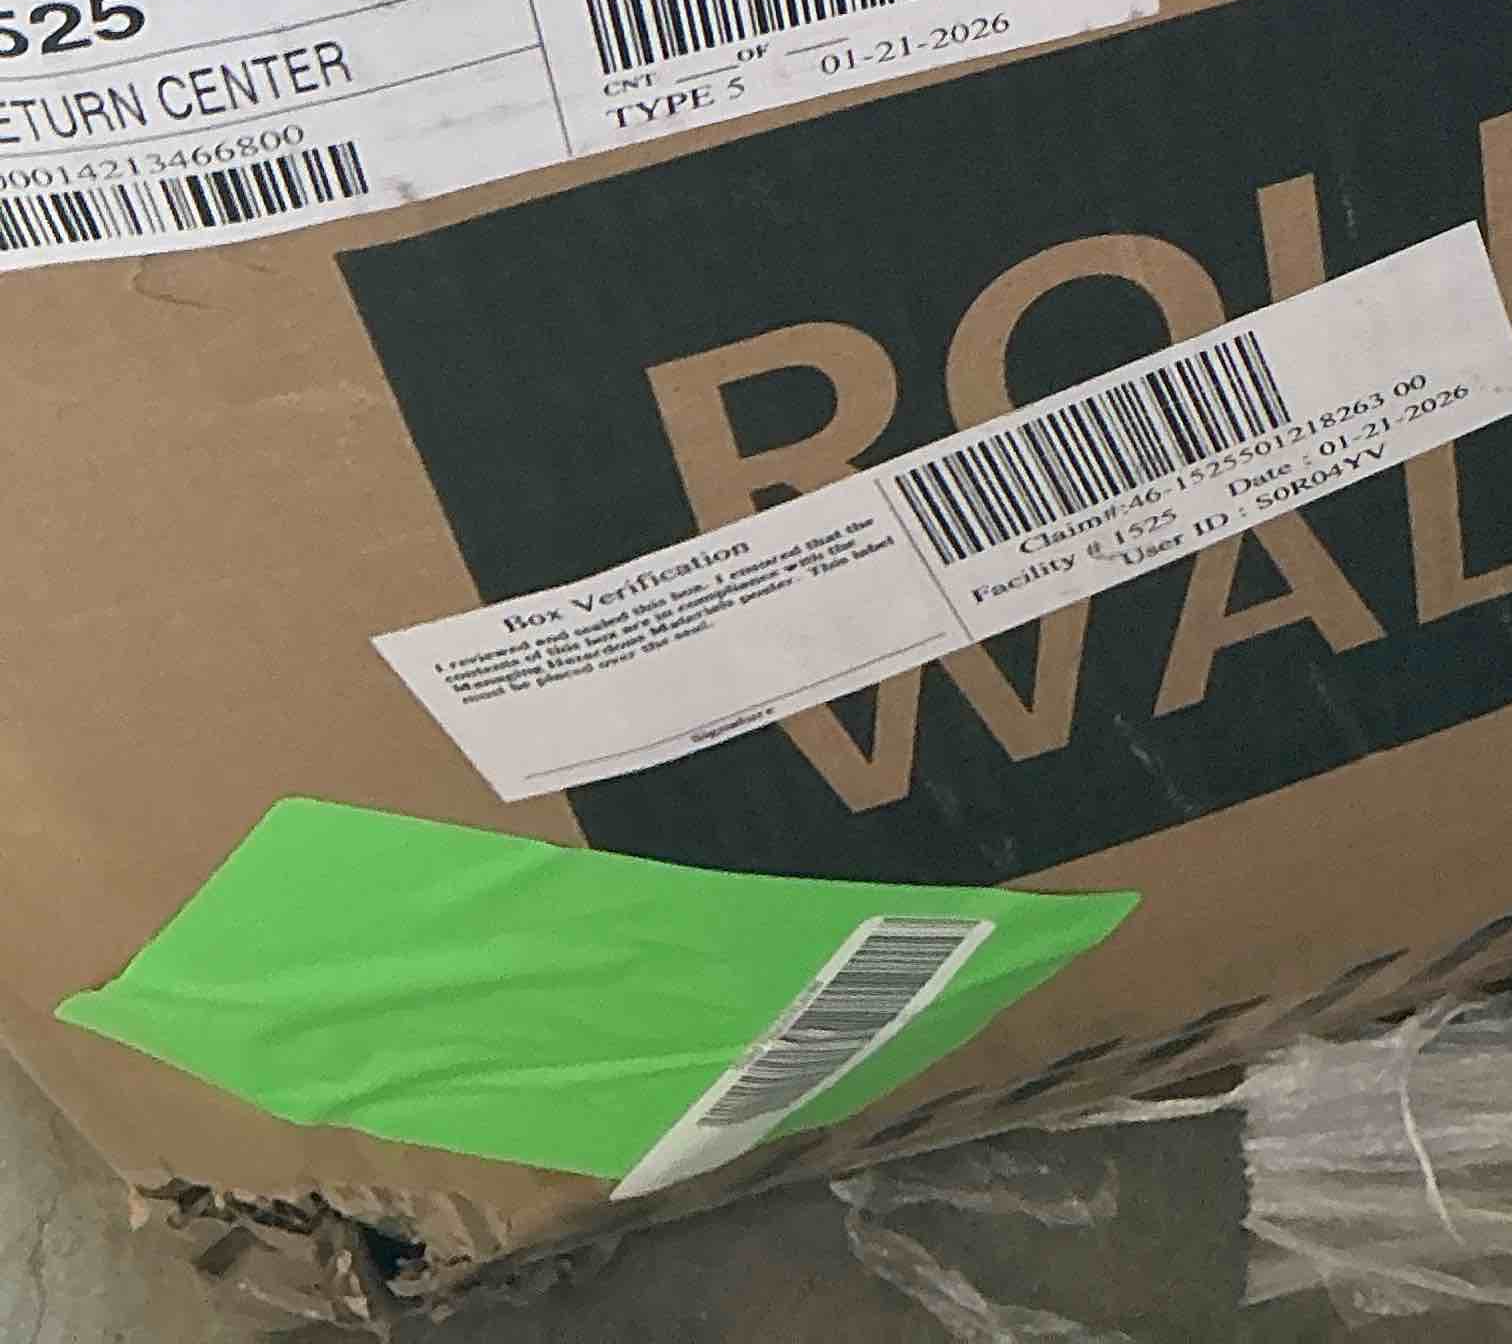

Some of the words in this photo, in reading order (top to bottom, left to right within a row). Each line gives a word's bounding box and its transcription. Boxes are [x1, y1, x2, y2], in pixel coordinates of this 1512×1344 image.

[157, 40, 353, 120] CENTER
[603, 72, 657, 97] CNT
[737, 43, 771, 63] OF
[605, 84, 717, 128] TYPE
[727, 76, 746, 100] 5
[819, 12, 1011, 76] 01-21-2026
[1393, 374, 1427, 397] 00
[971, 552, 1076, 605] Facility
[1087, 540, 1101, 558] #
[1114, 507, 1178, 545] 1525
[1226, 463, 1292, 497] Date
[1319, 384, 1469, 456] 01-21-2026
[1121, 533, 1186, 566] User
[1193, 511, 1230, 537] ID
[503, 608, 562, 633] Box
[571, 541, 751, 613] Verification
[535, 631, 570, 647] and
[805, 530, 842, 550] that
[846, 518, 874, 534] the
